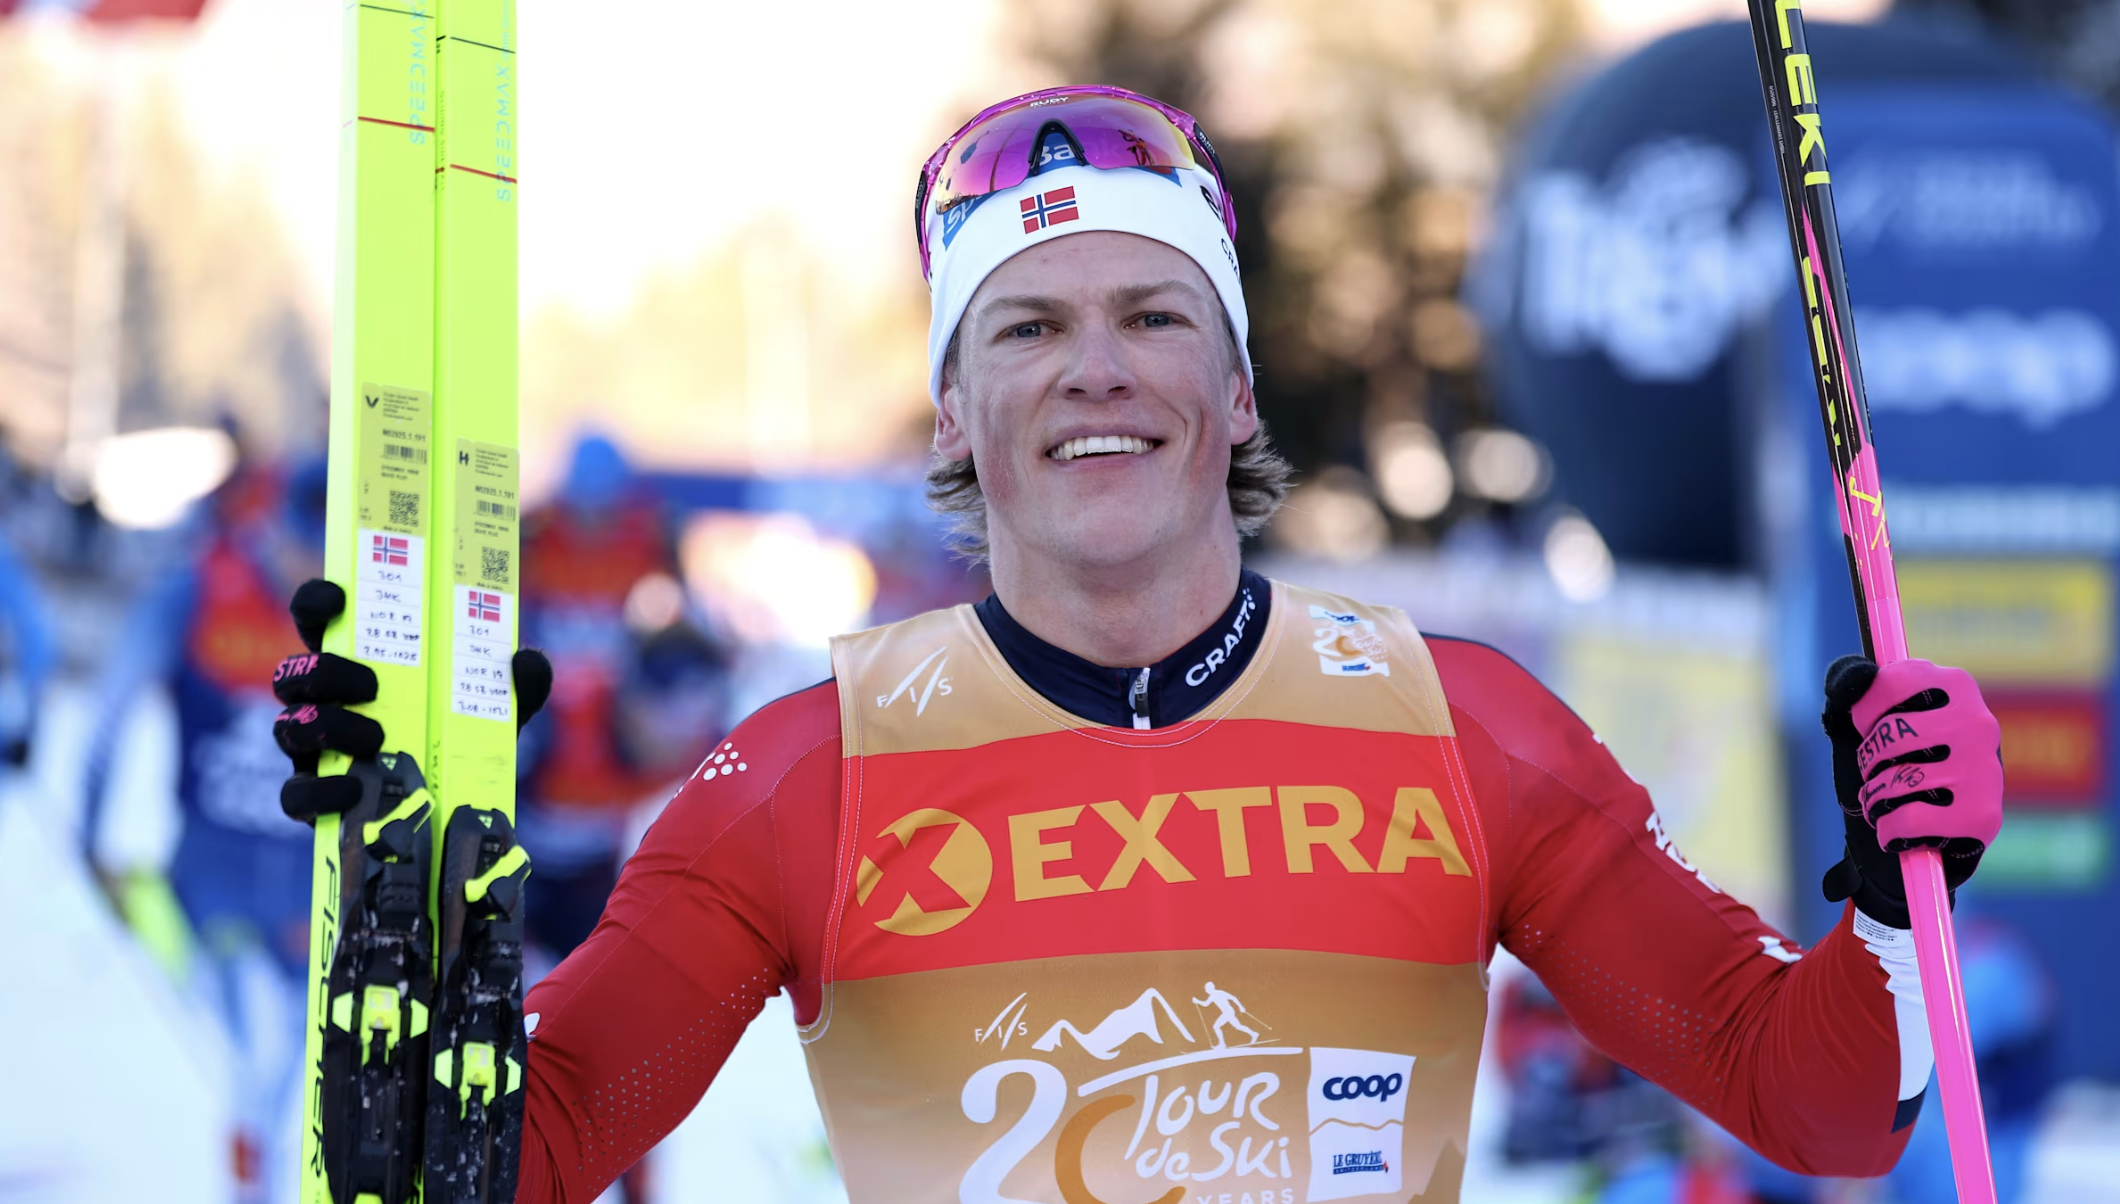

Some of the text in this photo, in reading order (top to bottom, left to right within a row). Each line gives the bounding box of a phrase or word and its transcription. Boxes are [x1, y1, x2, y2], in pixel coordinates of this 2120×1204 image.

[410, 9, 426, 145] SPEEDMAX
[1030, 97, 1069, 107] RUDY
[1775, 0, 1831, 187] LEKI
[496, 64, 511, 203] SPEEDMAX
[1185, 599, 1251, 687] CRAFT
[1007, 785, 1473, 903] EXTRA
[1322, 1072, 1403, 1103] coop
[1135, 1137, 1191, 1181] de
[1333, 1154, 1344, 1168] LE
